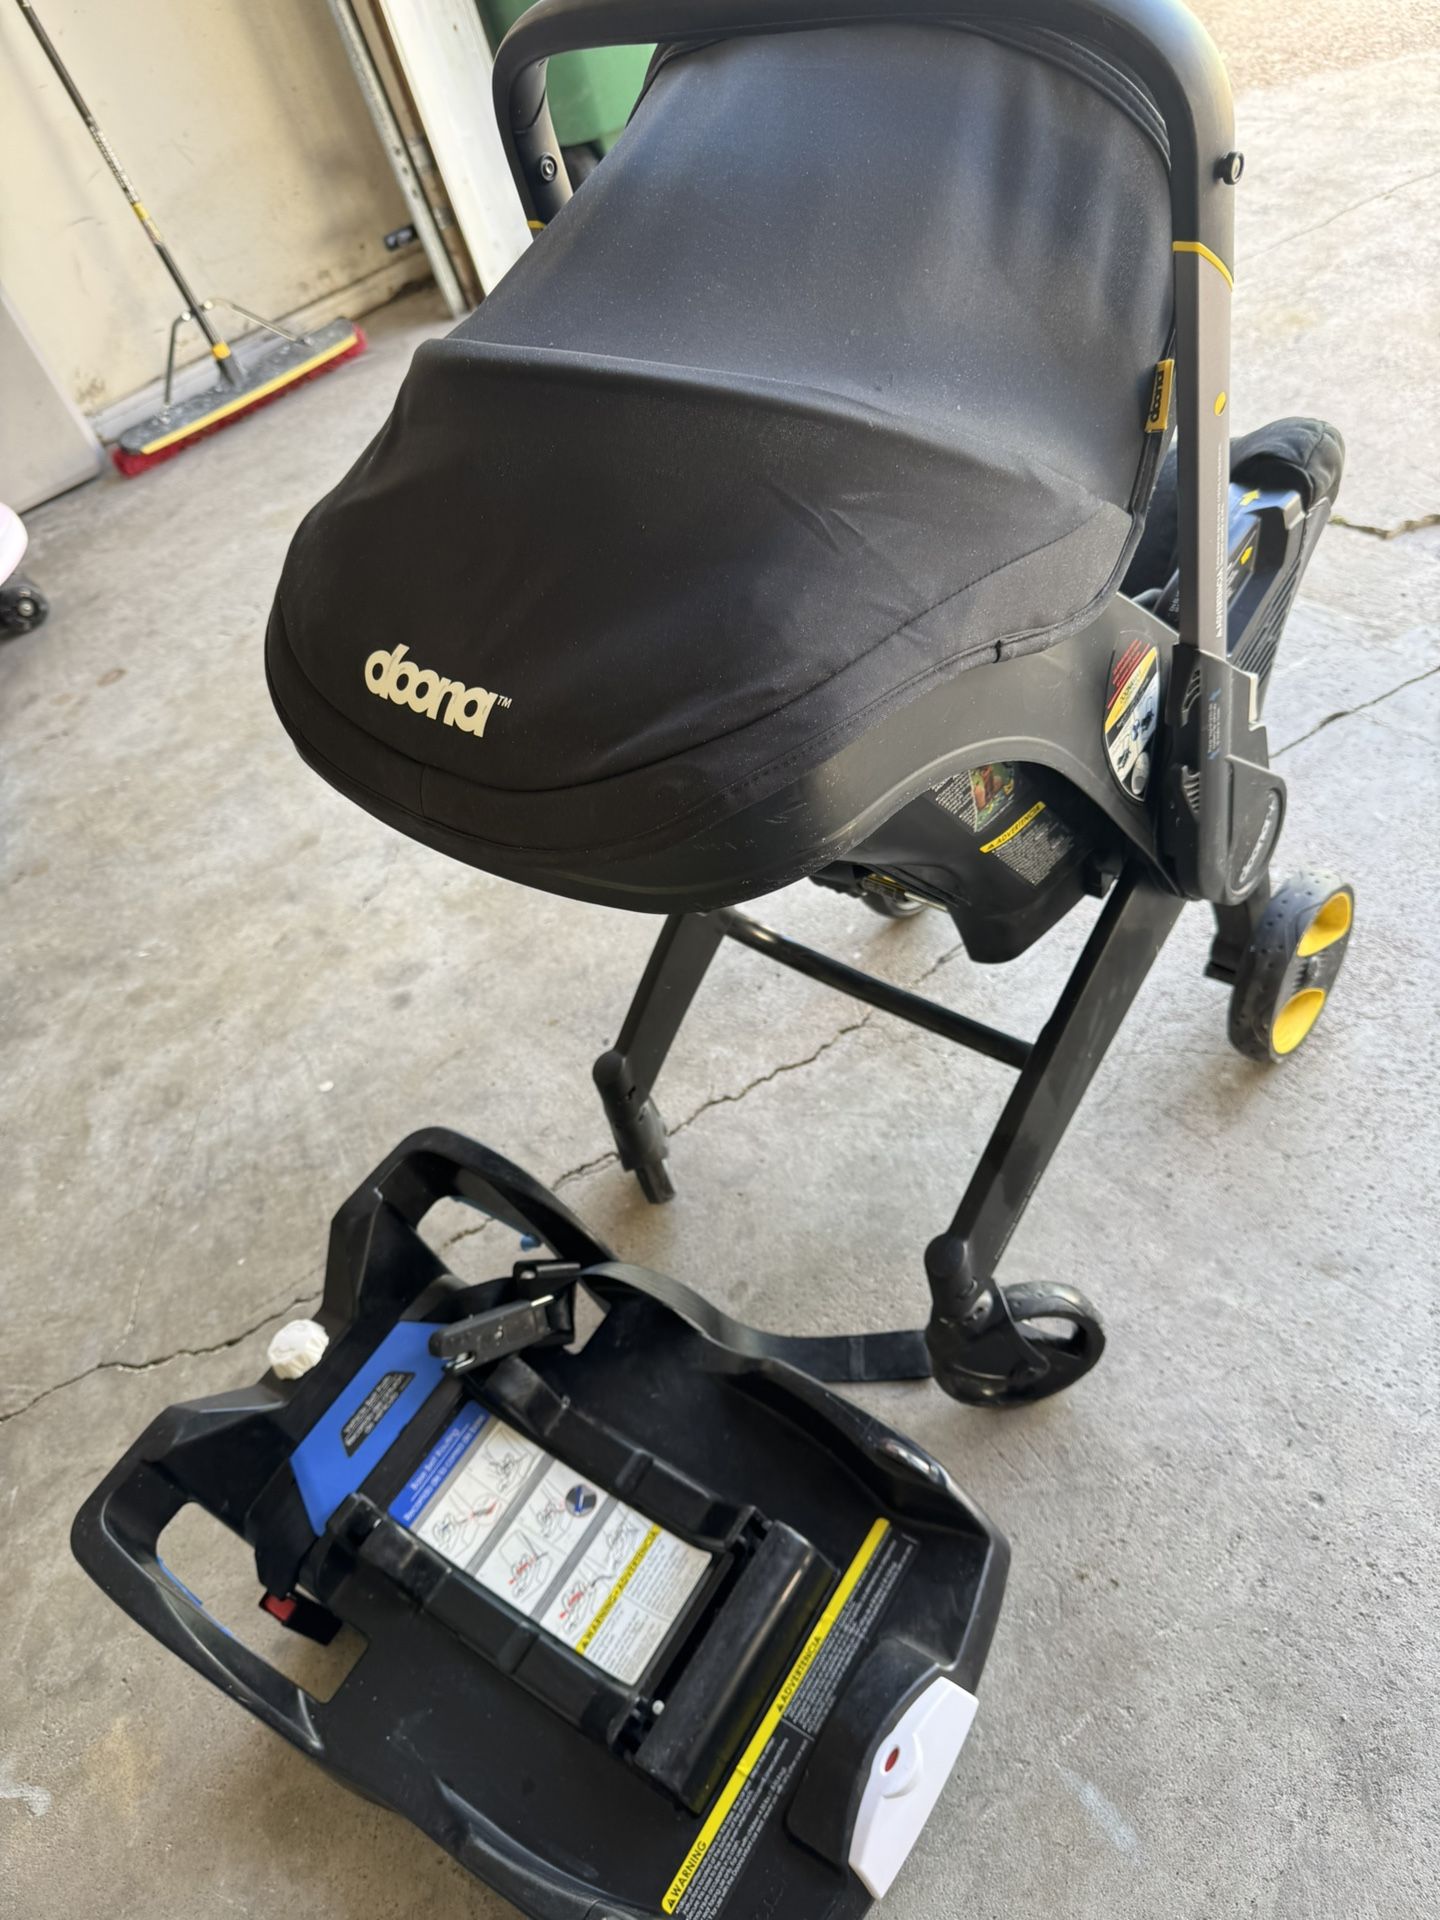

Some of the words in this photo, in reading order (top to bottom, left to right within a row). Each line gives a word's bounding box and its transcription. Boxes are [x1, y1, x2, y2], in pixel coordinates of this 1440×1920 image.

[1150, 371, 1165, 422] doona
[365, 643, 497, 738] doona
[996, 804, 1041, 844] ADVERTENCIA
[781, 1636, 821, 1703] ADVERTENCIA
[671, 1840, 707, 1897] WARNING
